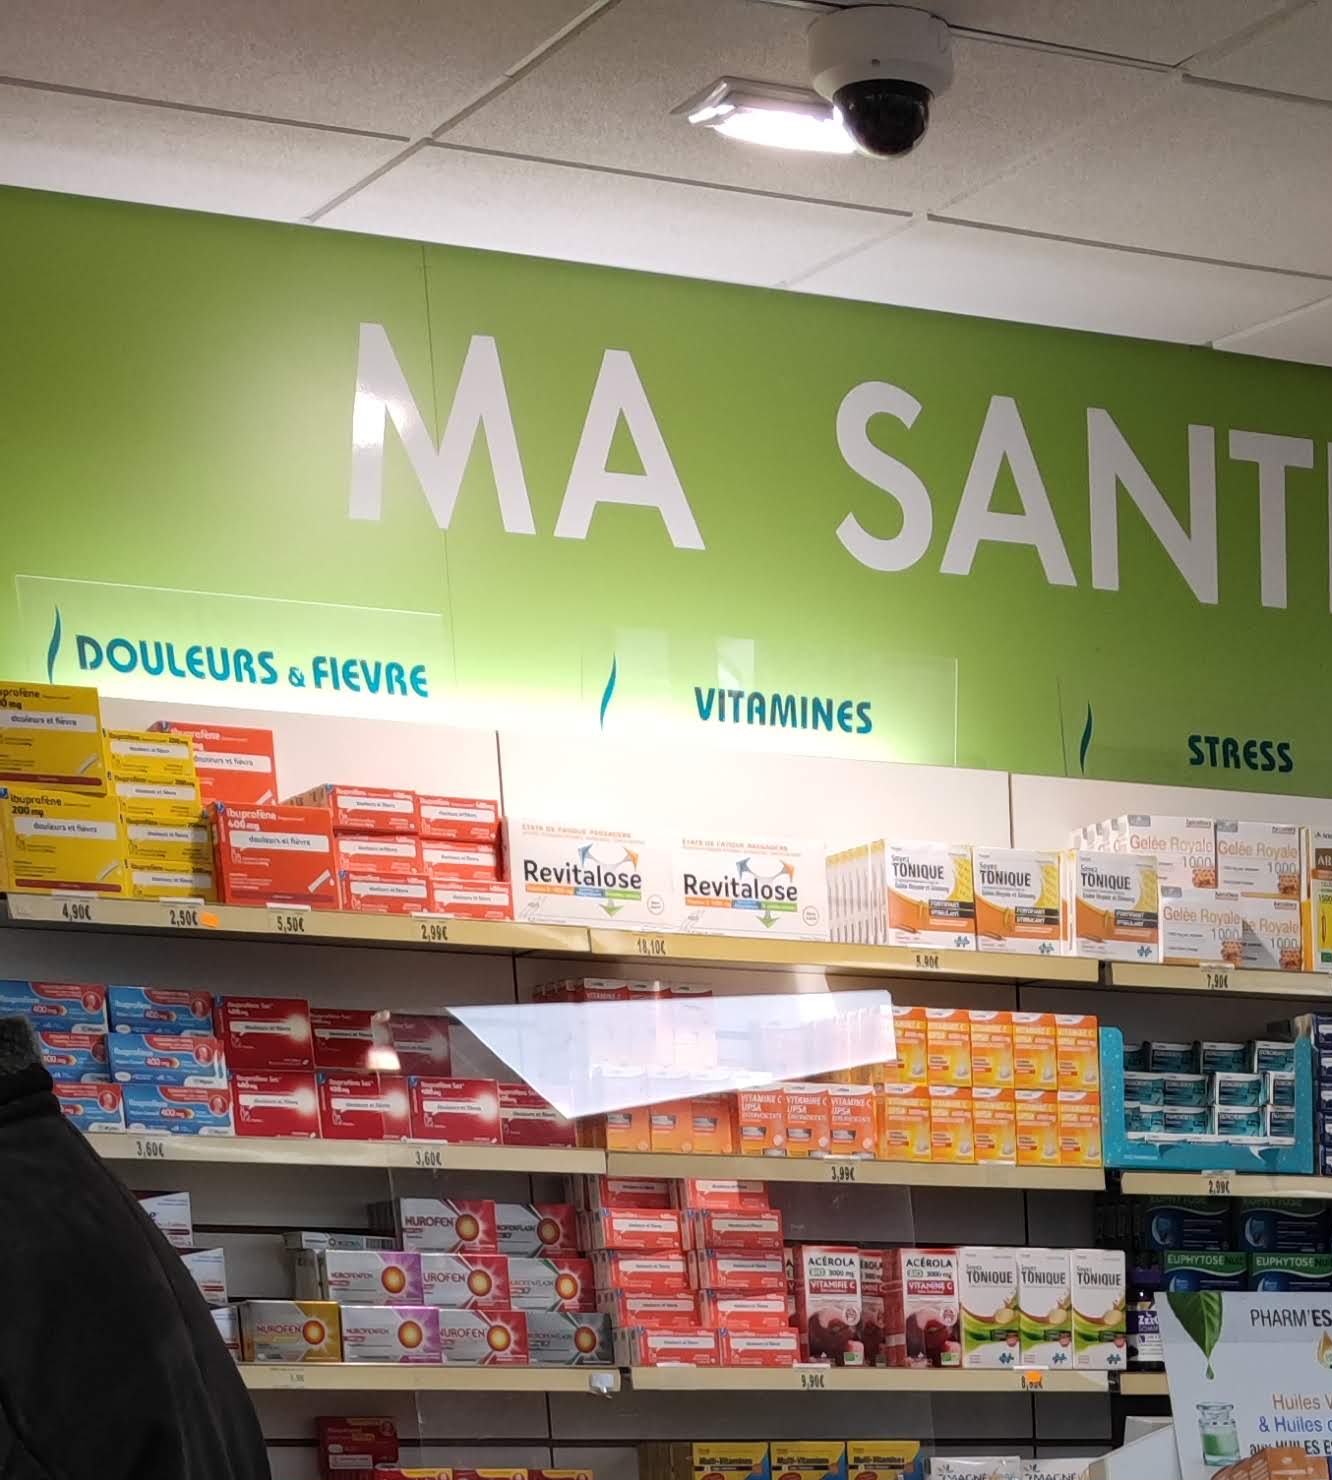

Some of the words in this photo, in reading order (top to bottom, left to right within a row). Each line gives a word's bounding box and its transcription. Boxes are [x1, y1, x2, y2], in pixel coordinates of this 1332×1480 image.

[347, 321, 706, 551] MA
[76, 632, 278, 687] DOULEURS
[287, 666, 306, 689] &
[313, 655, 429, 698] FIEVRE
[694, 686, 873, 736] VITAMINES
[1188, 733, 1295, 775] STRESS
[1130, 835, 1167, 850] Gelée
[1170, 836, 1214, 855] Royale
[1218, 841, 1253, 856] Gelée
[1256, 842, 1297, 862] Royale
[1183, 856, 1212, 869] 1000
[1267, 862, 1297, 874] 1000
[524, 859, 643, 890] Revitalose
[893, 862, 944, 881] TONIQUE
[980, 869, 1031, 888] TONIQUE
[684, 873, 798, 901] Revitalose
[1081, 872, 1131, 890] TONIQUE
[62, 903, 92, 921] 4,90€
[170, 909, 198, 926] 2,50€
[1163, 906, 1197, 921] Gelée
[1200, 908, 1242, 927] Royale
[277, 916, 305, 934] 5,50€
[1259, 918, 1299, 935] Royale
[1211, 928, 1239, 941] 1000
[1271, 937, 1298, 949] 1000
[136, 1140, 165, 1158] 3,60€
[415, 1150, 443, 1167] 3,60€
[831, 1166, 856, 1183] 3,99€
[405, 1216, 454, 1227] NUROFEN
[808, 1256, 855, 1268] ACÉROLA
[905, 1258, 953, 1269] ACÉROLA
[1167, 1254, 1225, 1266] EUPHYTOSE
[1256, 1256, 1316, 1268] EUPHYTOSE
[966, 1269, 1013, 1286] TONIQUE
[1021, 1270, 1067, 1286] TONIQUE
[1077, 1272, 1122, 1287] TONIQUE
[257, 1324, 301, 1333] NUROFEN
[801, 1374, 825, 1390] 9,90€
[1273, 1393, 1320, 1411] Huiles
[1258, 1417, 1270, 1432] &
[1274, 1415, 1322, 1433] Huiles
